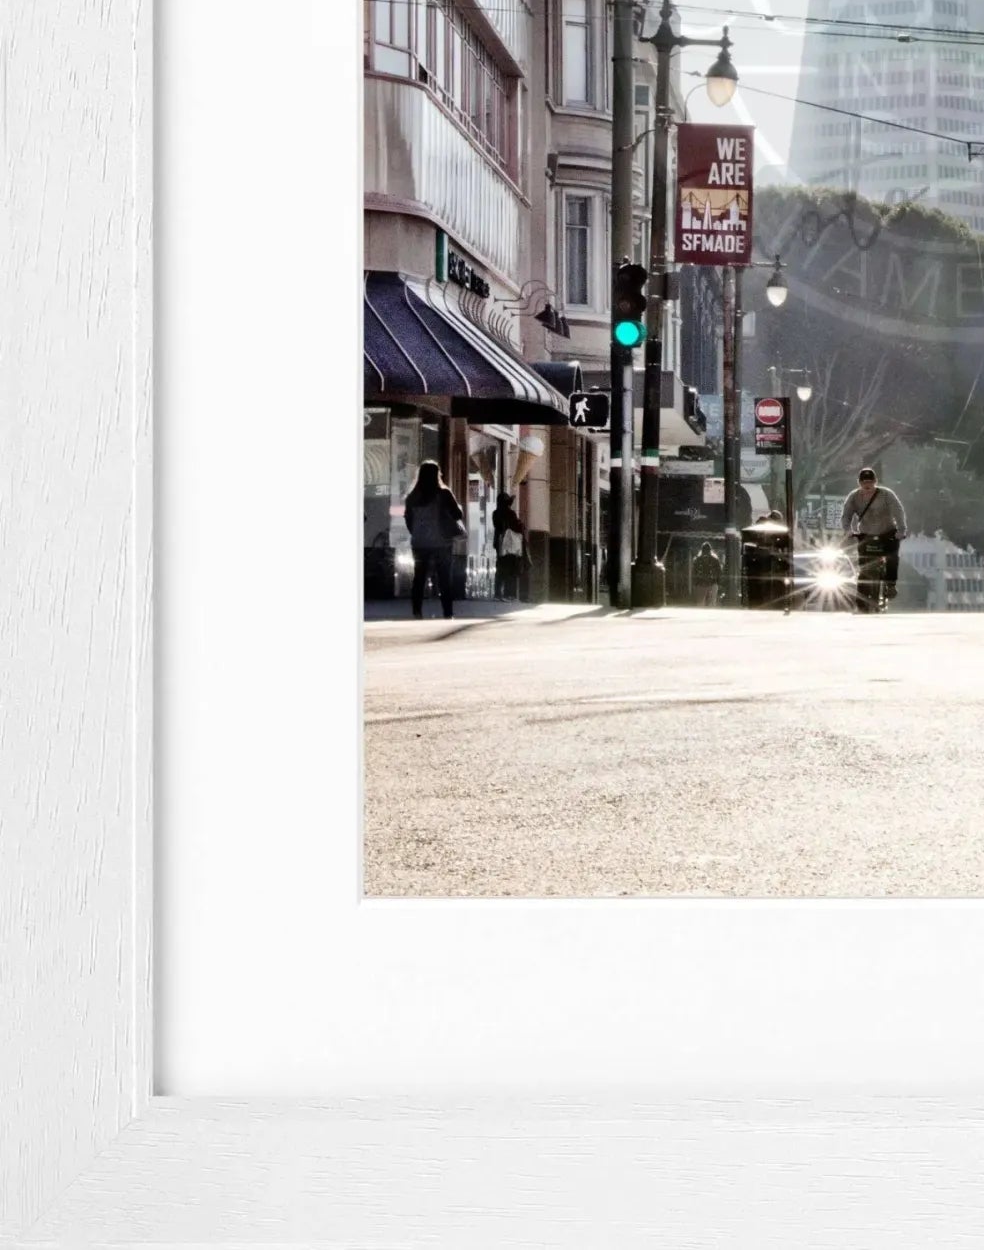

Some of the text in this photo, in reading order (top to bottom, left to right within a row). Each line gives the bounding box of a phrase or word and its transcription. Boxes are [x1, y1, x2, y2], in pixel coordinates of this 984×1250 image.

[716, 137, 746, 161] WE
[707, 161, 746, 186] ARE
[681, 233, 745, 254] SFMADE
